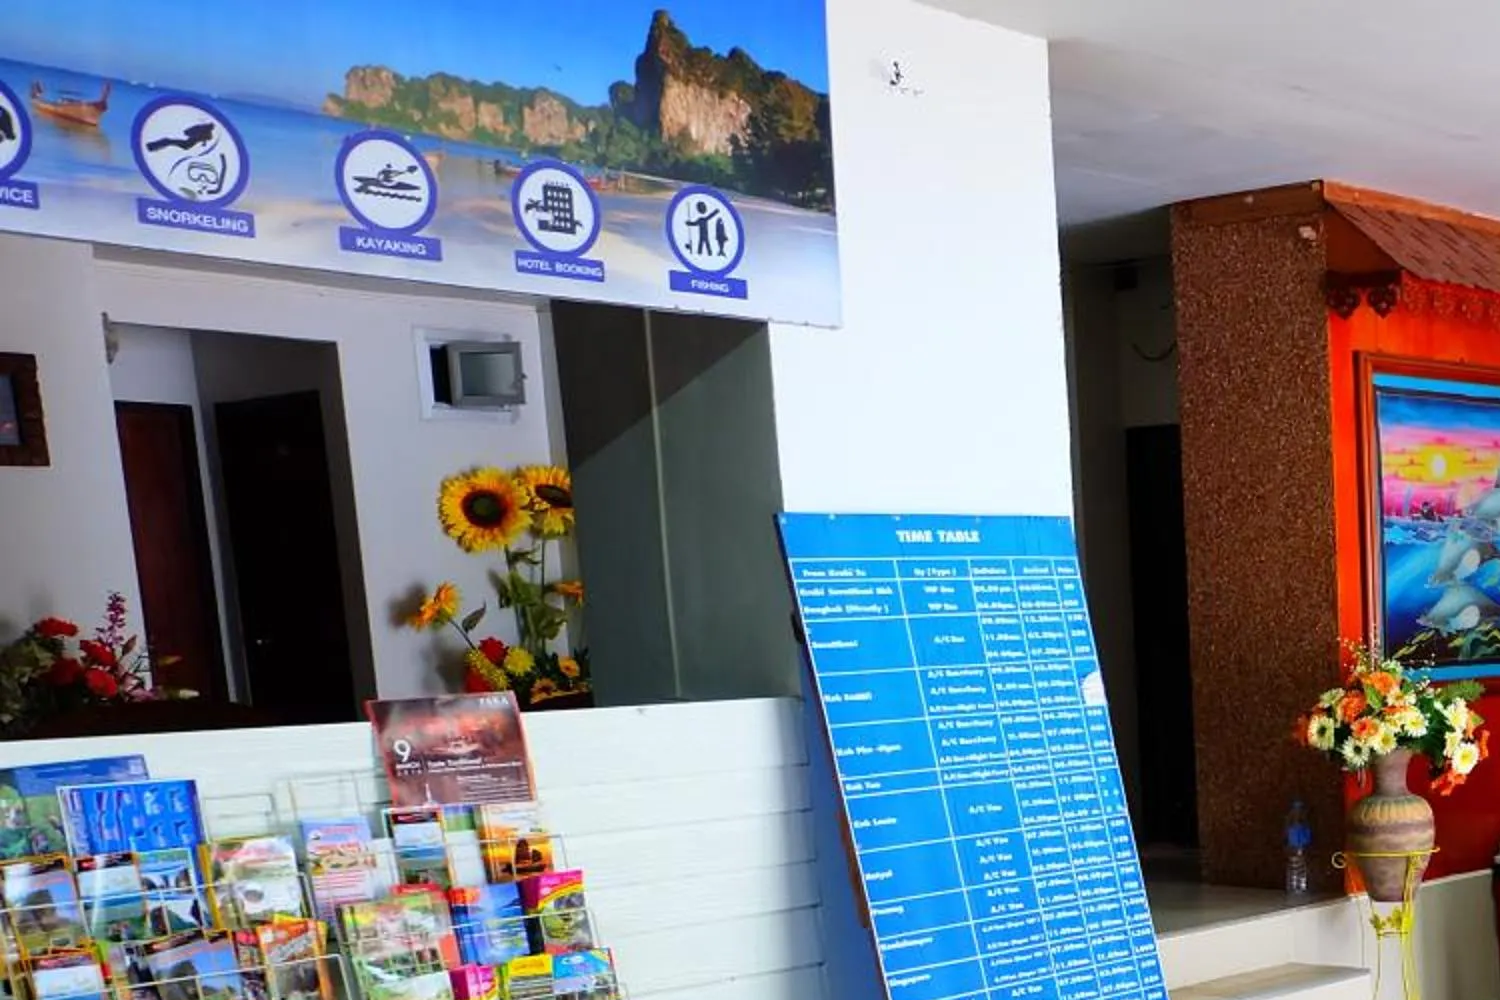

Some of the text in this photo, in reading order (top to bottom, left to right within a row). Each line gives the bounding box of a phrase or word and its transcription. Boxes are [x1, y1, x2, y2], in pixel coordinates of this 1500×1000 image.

[145, 206, 249, 233] SNORKELING
[355, 236, 427, 256] KAYAKING
[517, 257, 604, 277] HOTEL BOOKING
[690, 278, 730, 293] FISHING
[895, 529, 981, 544] TIME TABLE
[393, 738, 412, 763] 9
